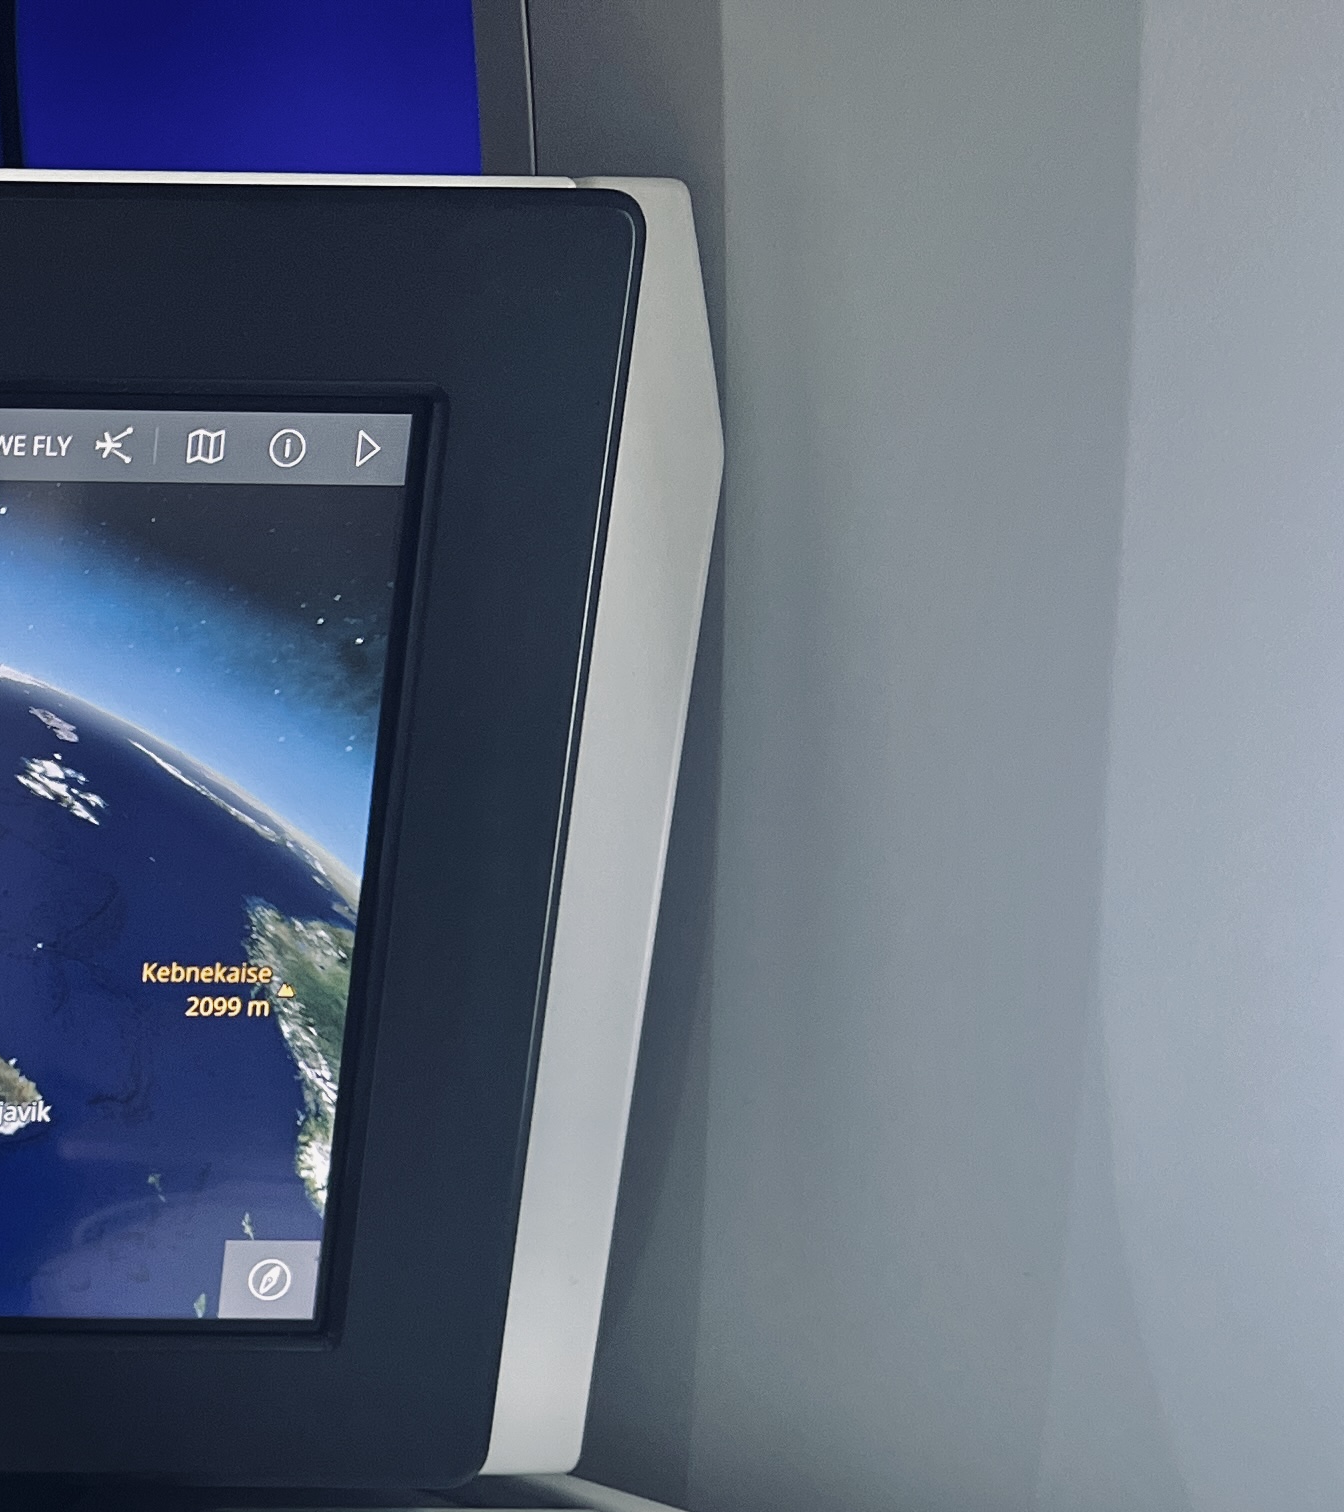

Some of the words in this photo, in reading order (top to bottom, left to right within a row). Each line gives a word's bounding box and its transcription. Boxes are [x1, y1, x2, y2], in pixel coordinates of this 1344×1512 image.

[32, 434, 73, 457] FLY
[142, 961, 272, 983] Kebnekaise
[185, 996, 242, 1017] 2099
[247, 1000, 270, 1017] m
